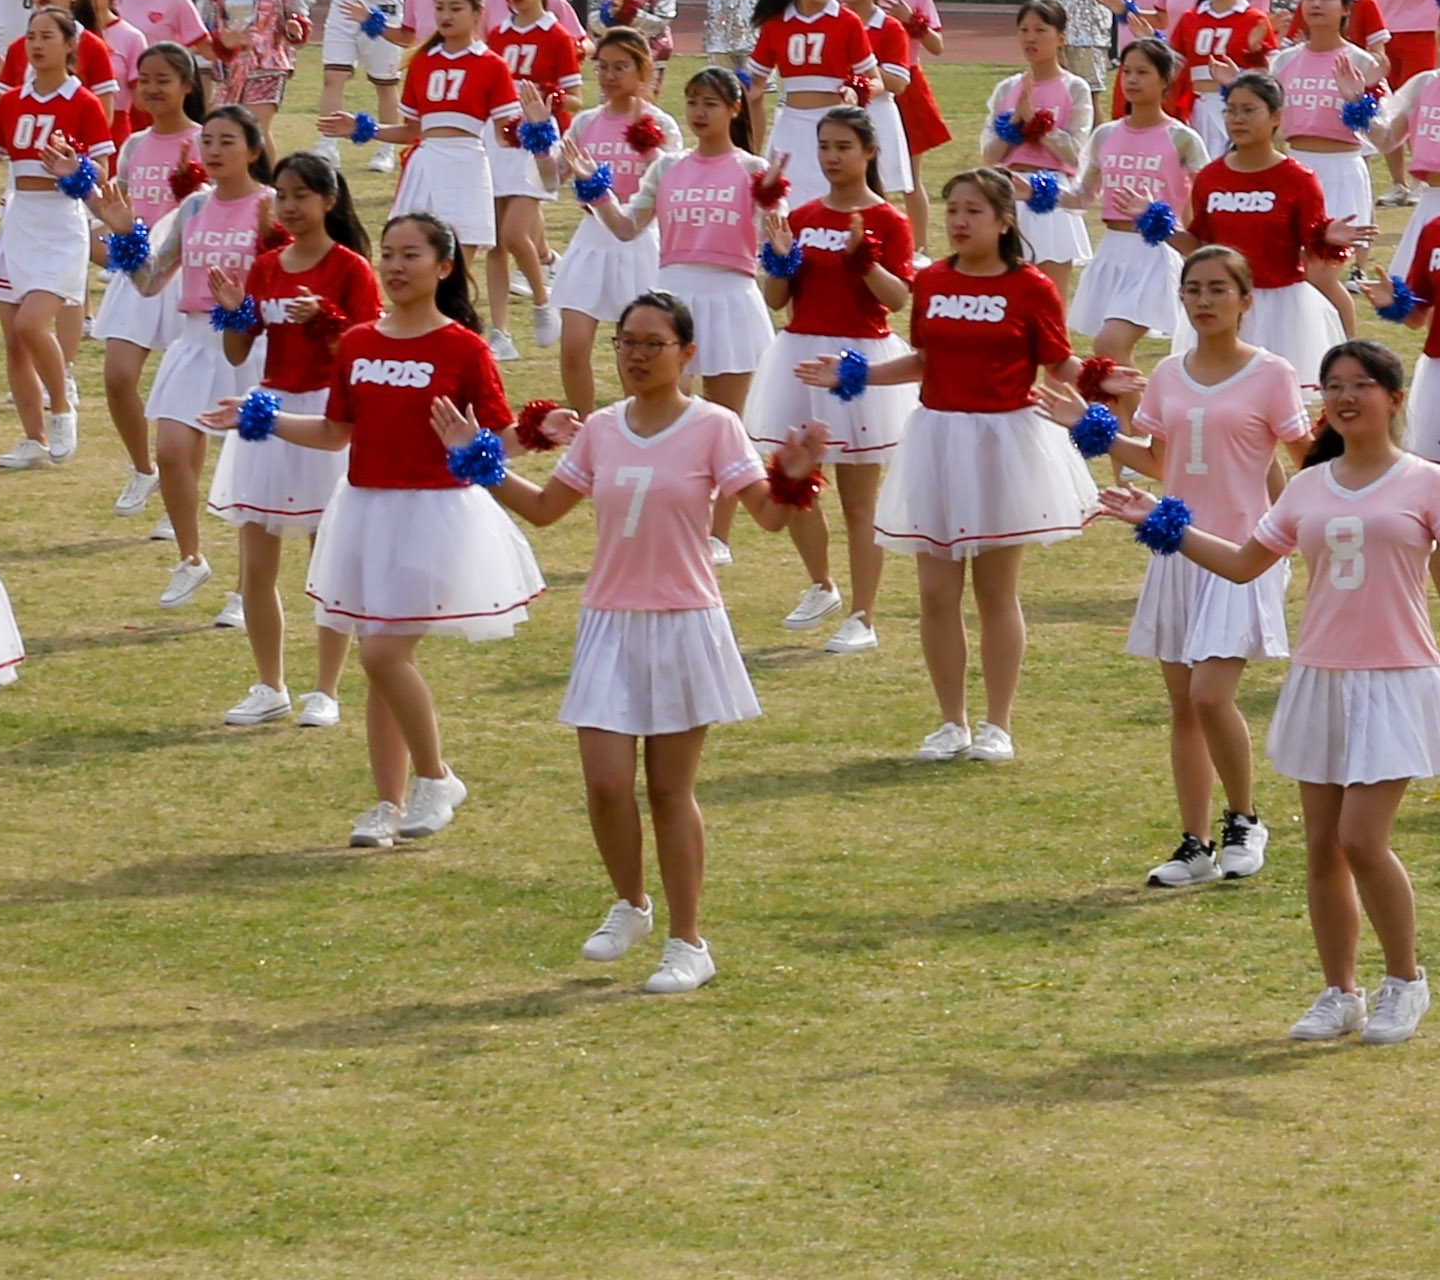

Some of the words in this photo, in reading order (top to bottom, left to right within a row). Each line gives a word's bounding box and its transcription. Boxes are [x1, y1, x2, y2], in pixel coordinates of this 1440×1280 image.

[788, 32, 825, 65] 07
[1196, 27, 1234, 56] 07
[503, 44, 539, 74] 07
[428, 69, 466, 101] 07
[14, 115, 55, 149] 07
[132, 162, 172, 180] aci
[1103, 152, 1163, 171] acid
[669, 184, 736, 203] acid
[1208, 192, 1276, 213] PARIS
[187, 228, 257, 247] acid
[926, 294, 1007, 322] PARIS
[351, 359, 434, 387] PARIS
[1185, 407, 1209, 474] 1
[616, 466, 654, 537] 7
[1324, 516, 1365, 590] 8
